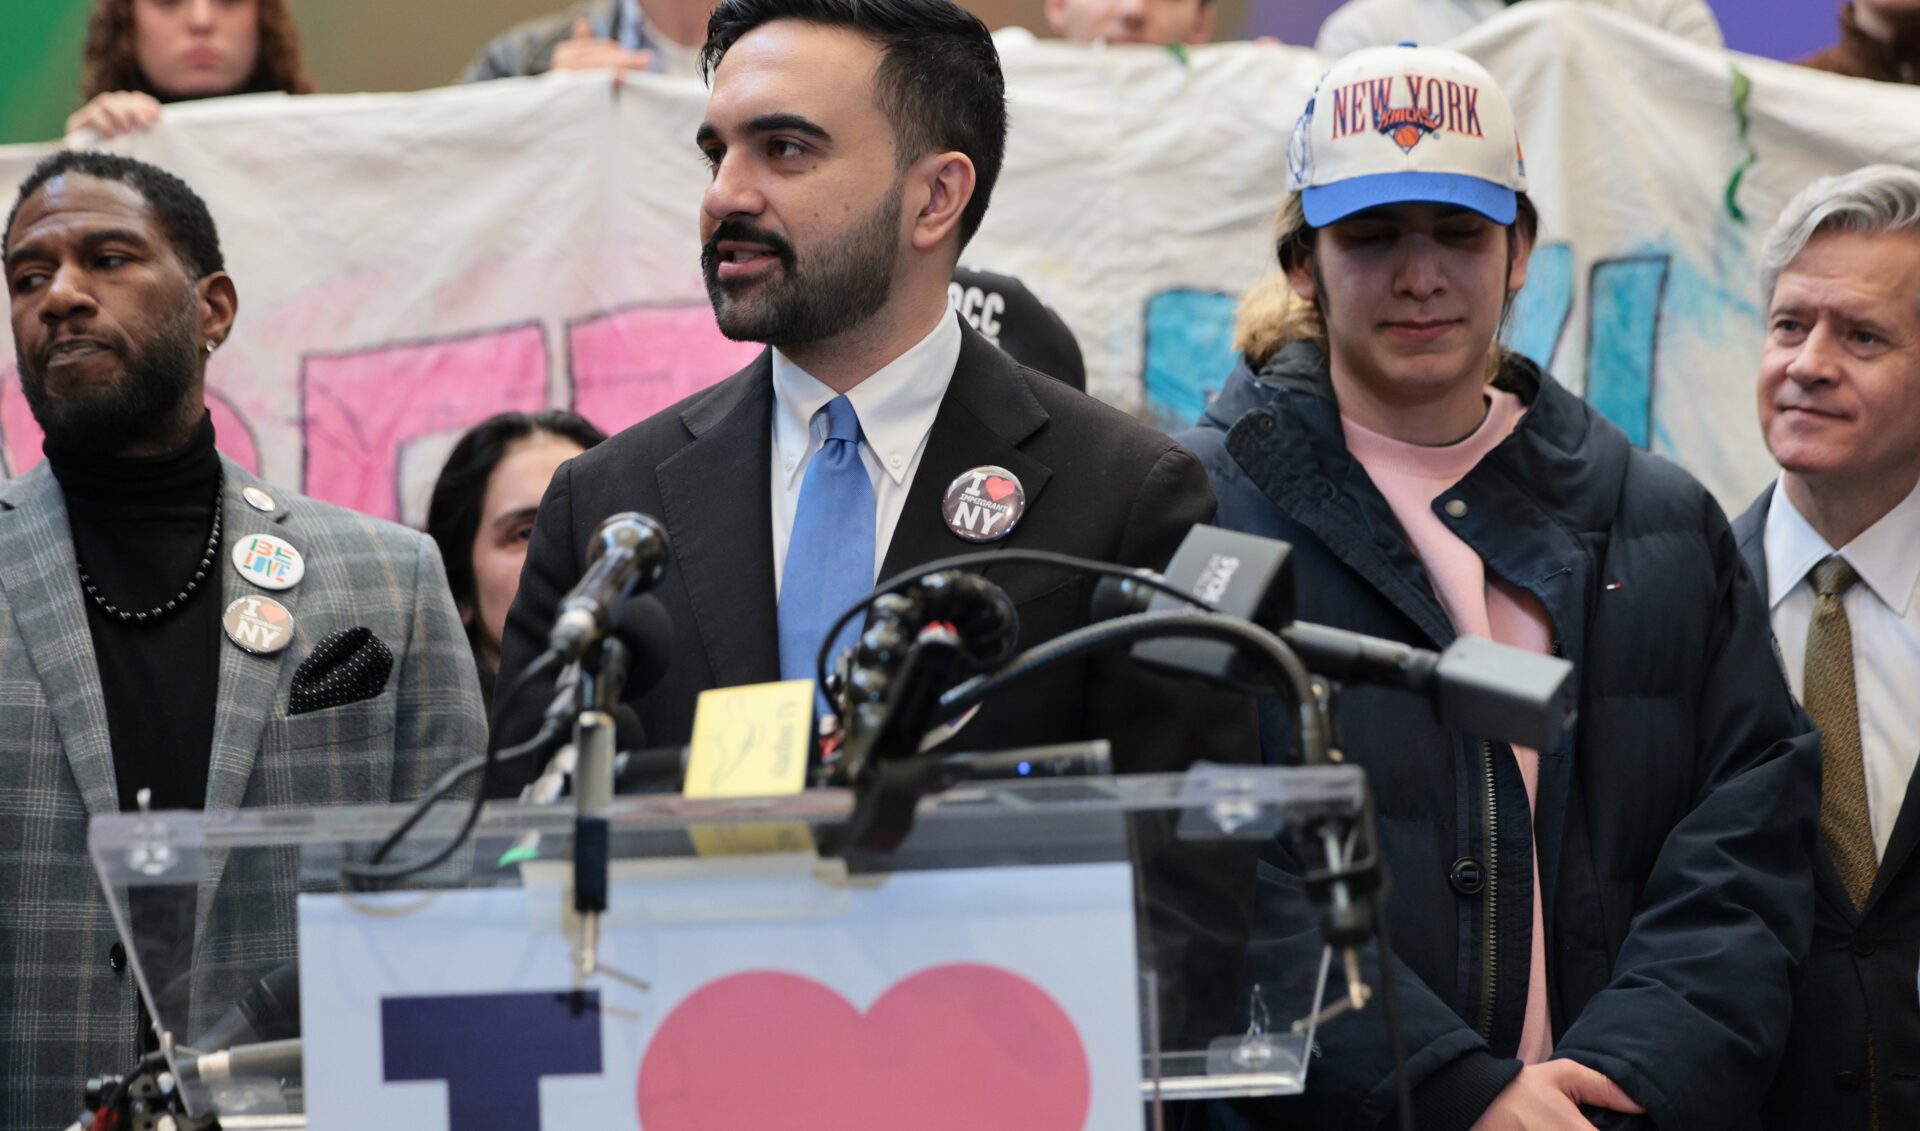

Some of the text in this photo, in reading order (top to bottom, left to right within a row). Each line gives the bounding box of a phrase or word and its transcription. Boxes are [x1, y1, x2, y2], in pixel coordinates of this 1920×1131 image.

[1331, 73, 1486, 141] NEW YORK
[1377, 107, 1438, 131] KNICKS
[965, 471, 988, 497] I
[959, 493, 1009, 514] IMMIGRANT
[952, 501, 1004, 536] NY
[250, 538, 296, 566] BE
[243, 551, 292, 584] LOVE
[243, 598, 262, 618] I
[234, 619, 281, 649] NY
